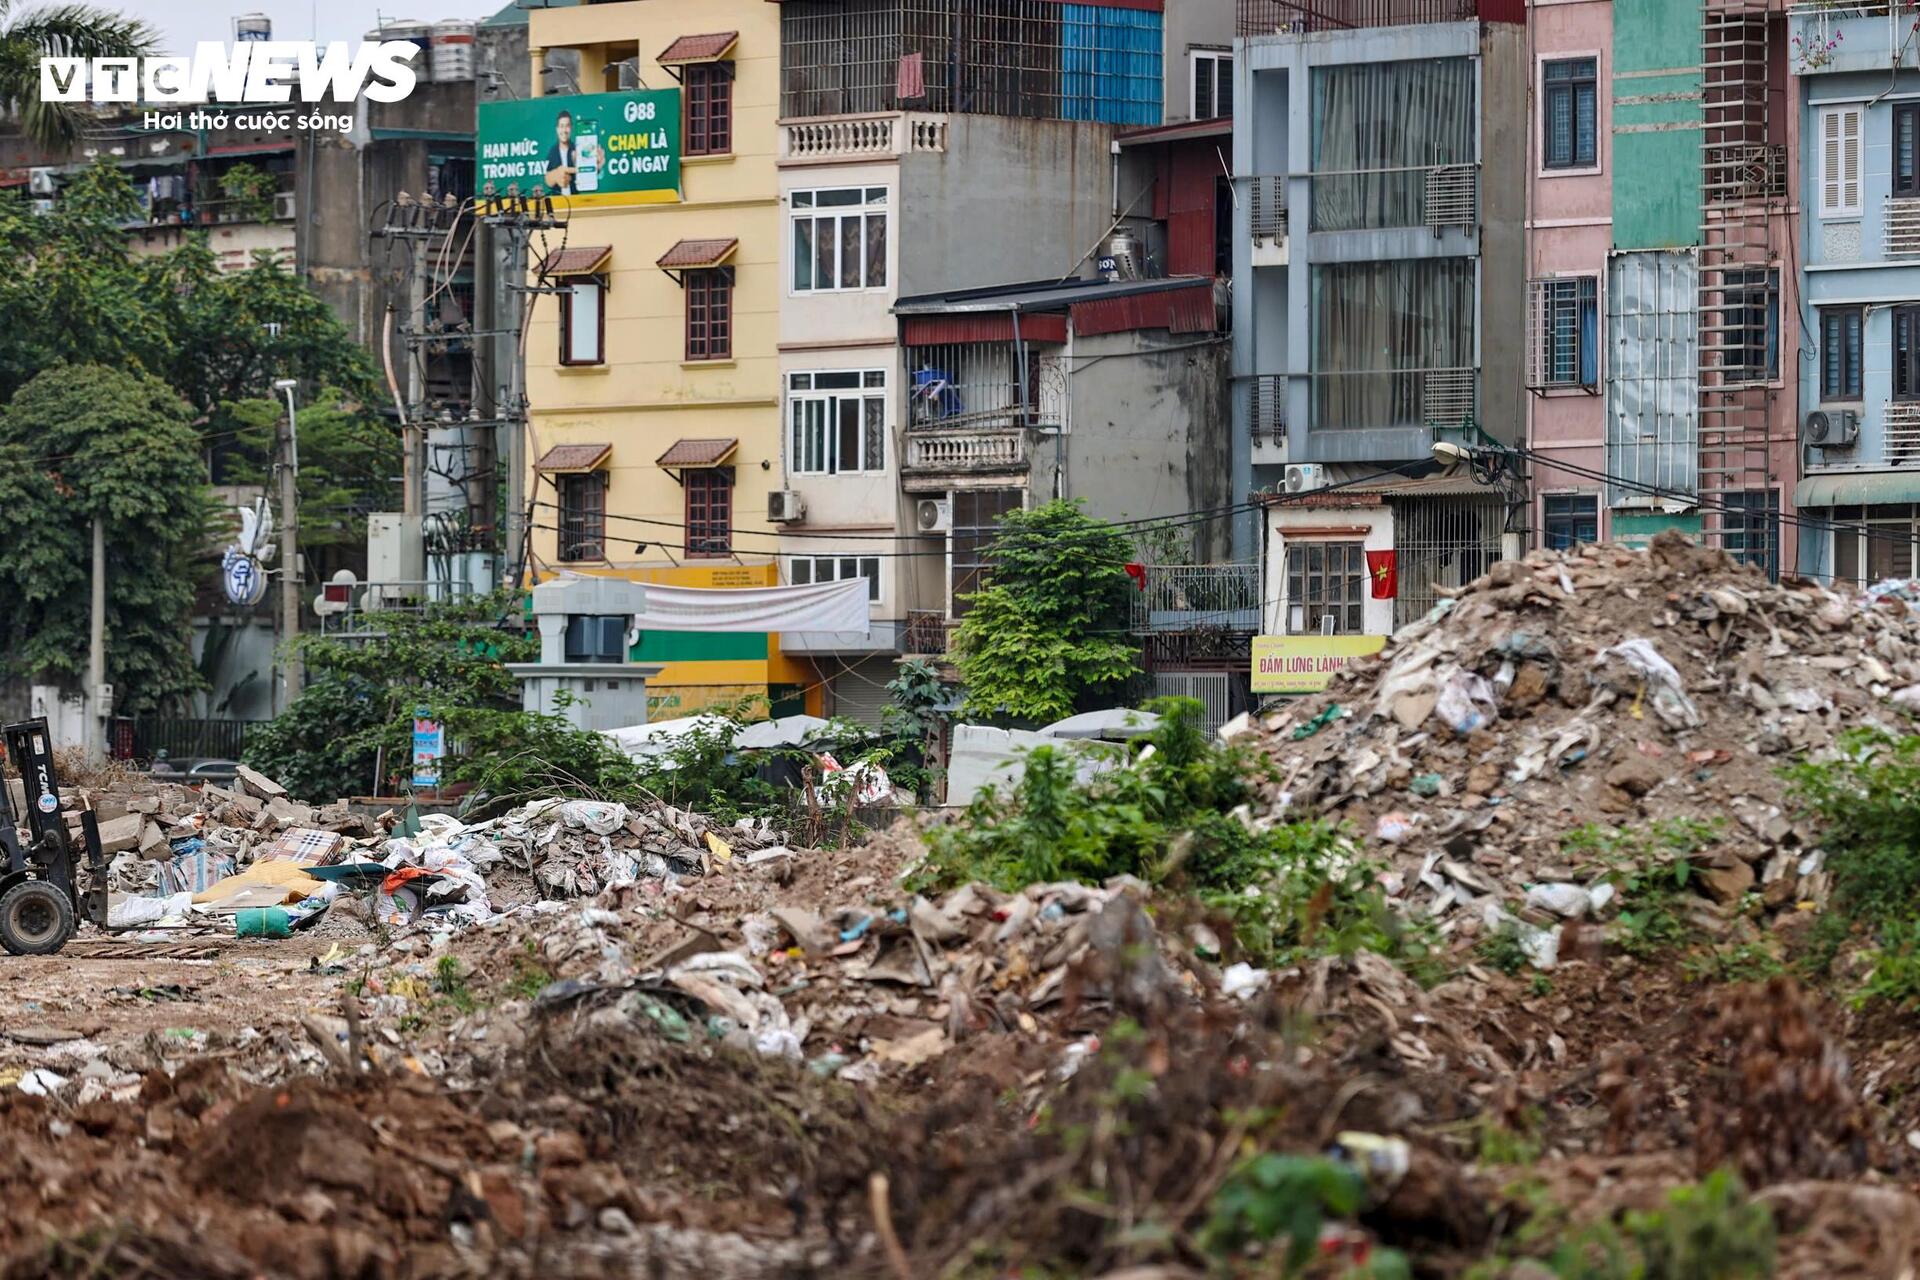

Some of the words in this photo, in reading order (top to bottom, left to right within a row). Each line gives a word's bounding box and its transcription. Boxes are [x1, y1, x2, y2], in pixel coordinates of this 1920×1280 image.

[483, 143, 509, 163] HẠN
[510, 138, 538, 157] MỨC
[608, 133, 648, 155] CHẠM
[651, 128, 668, 148] LÀ
[483, 163, 525, 179] TRONG
[527, 160, 549, 175] TAY
[608, 153, 630, 175] CÓ
[632, 155, 670, 173] NGAY
[1260, 653, 1283, 673] ĐẤM
[37, 764, 50, 794] TCM
